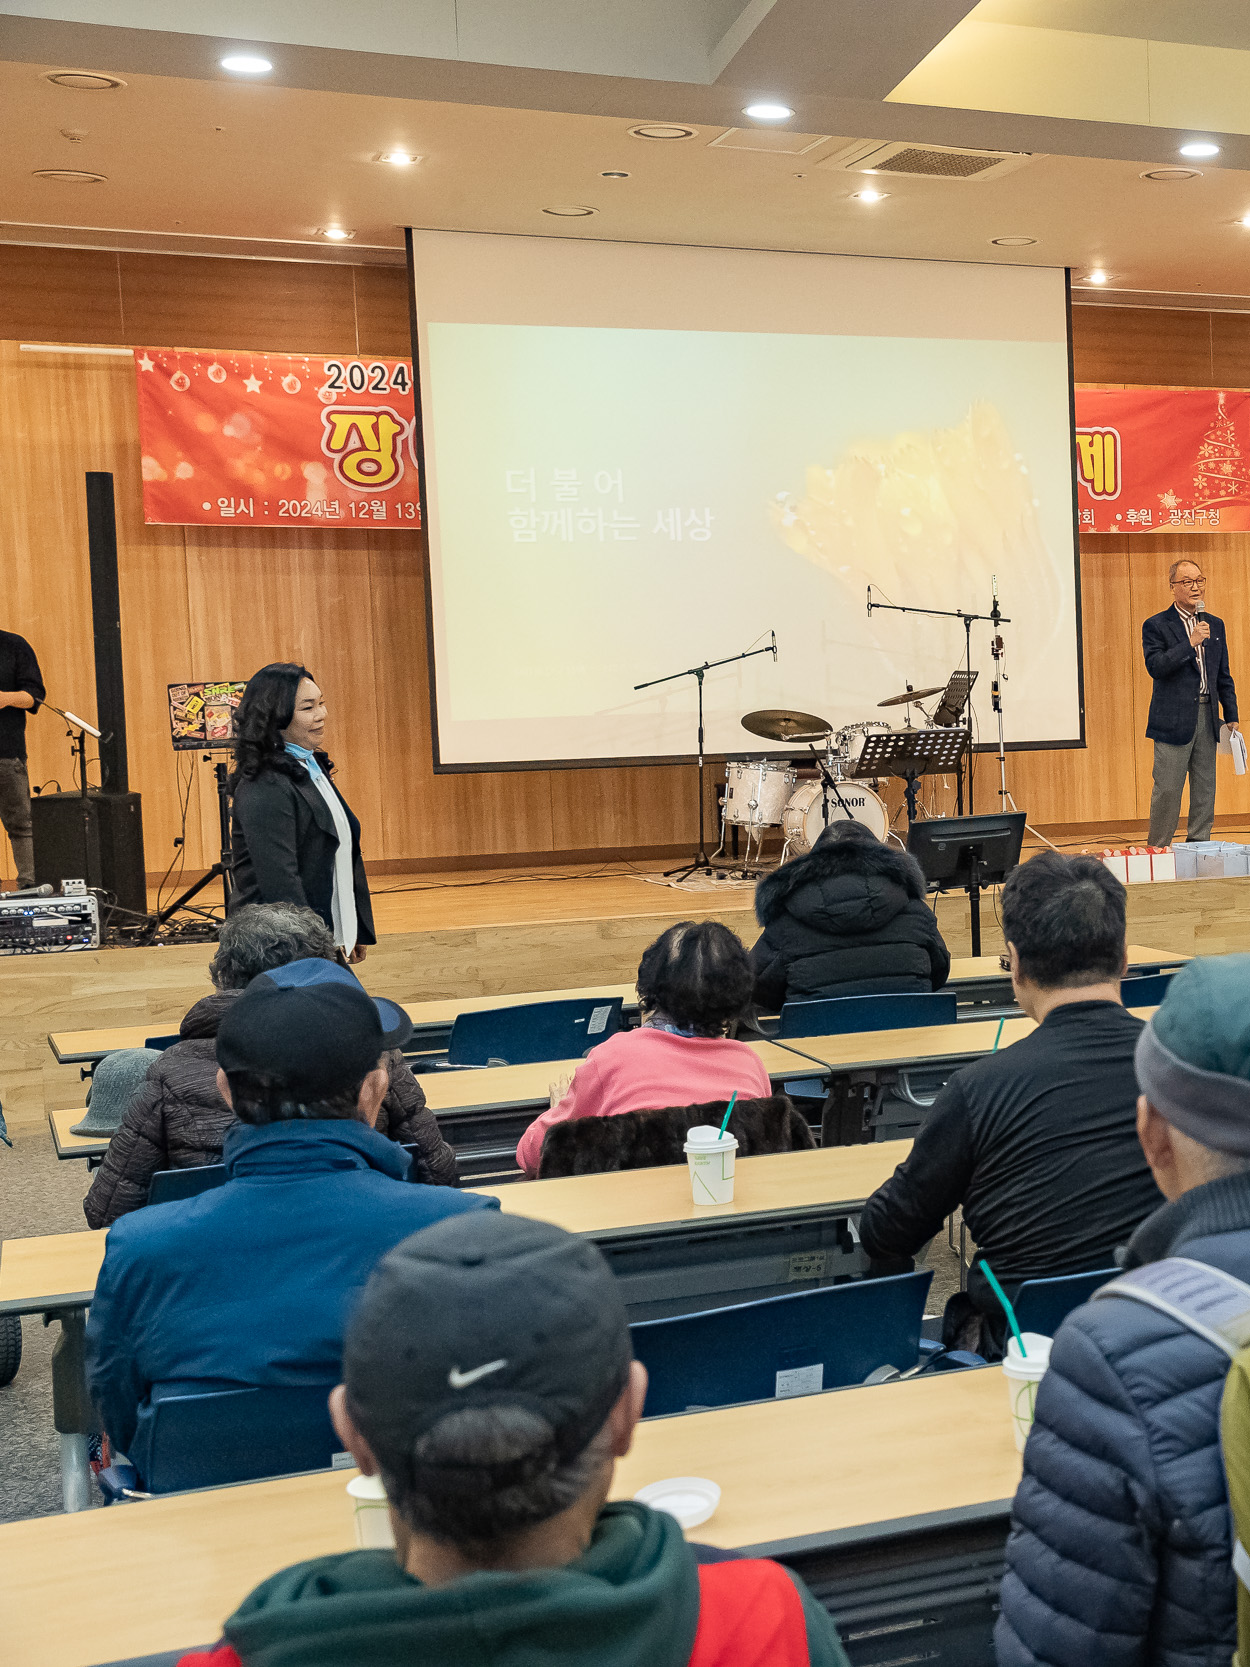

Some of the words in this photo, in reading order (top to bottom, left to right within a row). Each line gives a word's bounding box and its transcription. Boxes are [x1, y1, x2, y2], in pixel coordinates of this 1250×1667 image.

[325, 361, 412, 394] 2024
[322, 406, 411, 491] 장
[505, 468, 536, 503] 더
[550, 467, 583, 502] 불
[594, 467, 625, 503] 어
[217, 497, 254, 517] 일시
[278, 499, 341, 519] 2024년
[349, 501, 387, 520] 12월
[507, 506, 641, 543] 함께하는
[652, 506, 715, 542] 세상
[1126, 508, 1153, 526] 후원
[1168, 508, 1221, 526] 광진구청
[831, 797, 866, 808] SONOR
